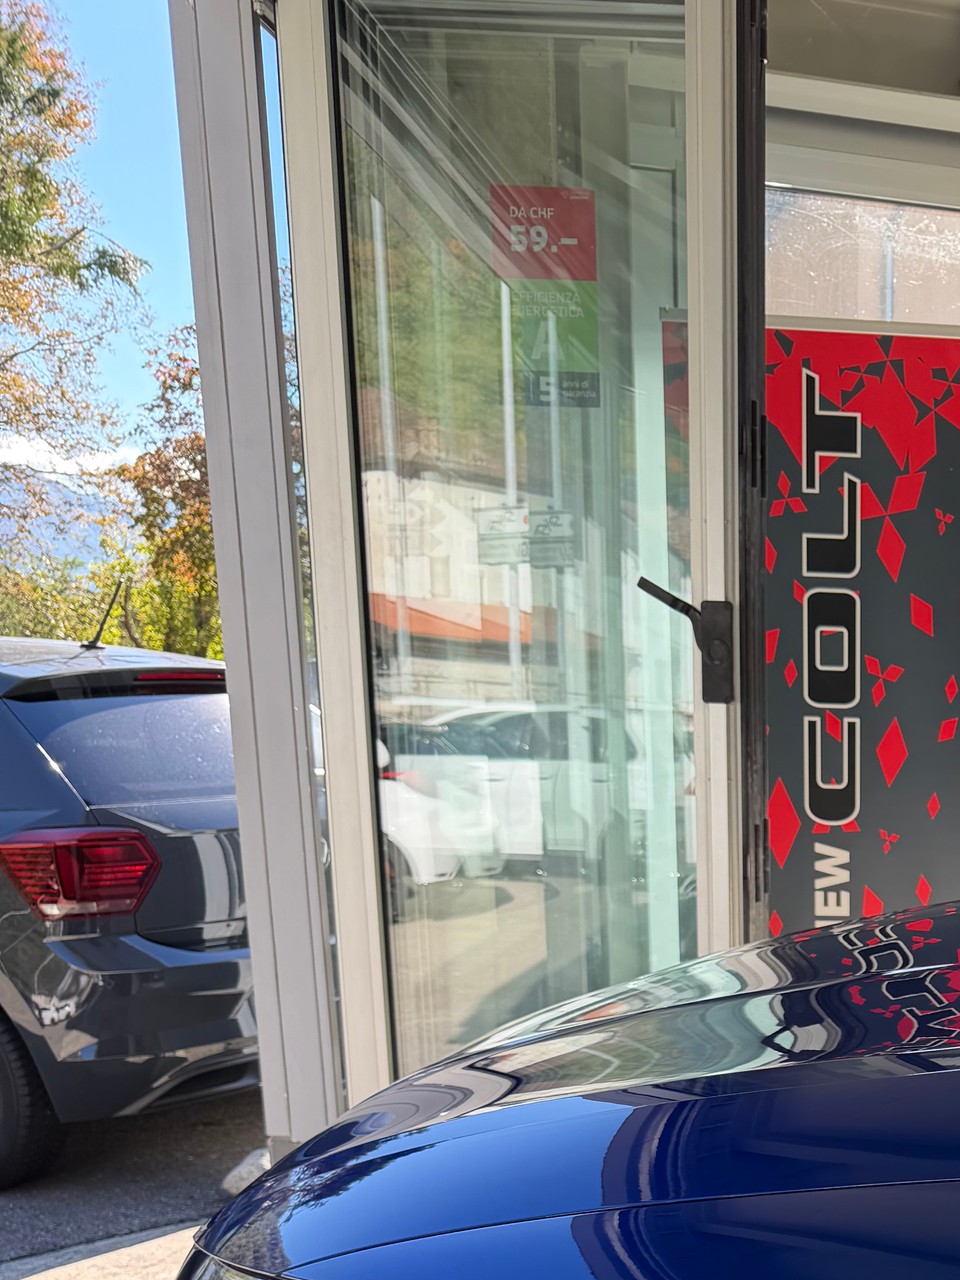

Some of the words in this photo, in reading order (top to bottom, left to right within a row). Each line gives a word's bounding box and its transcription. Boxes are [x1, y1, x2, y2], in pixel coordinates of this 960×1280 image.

[509, 206, 527, 218] DA
[530, 207, 554, 219] CHF
[802, 366, 861, 826] COLT
[813, 841, 851, 928] EW
